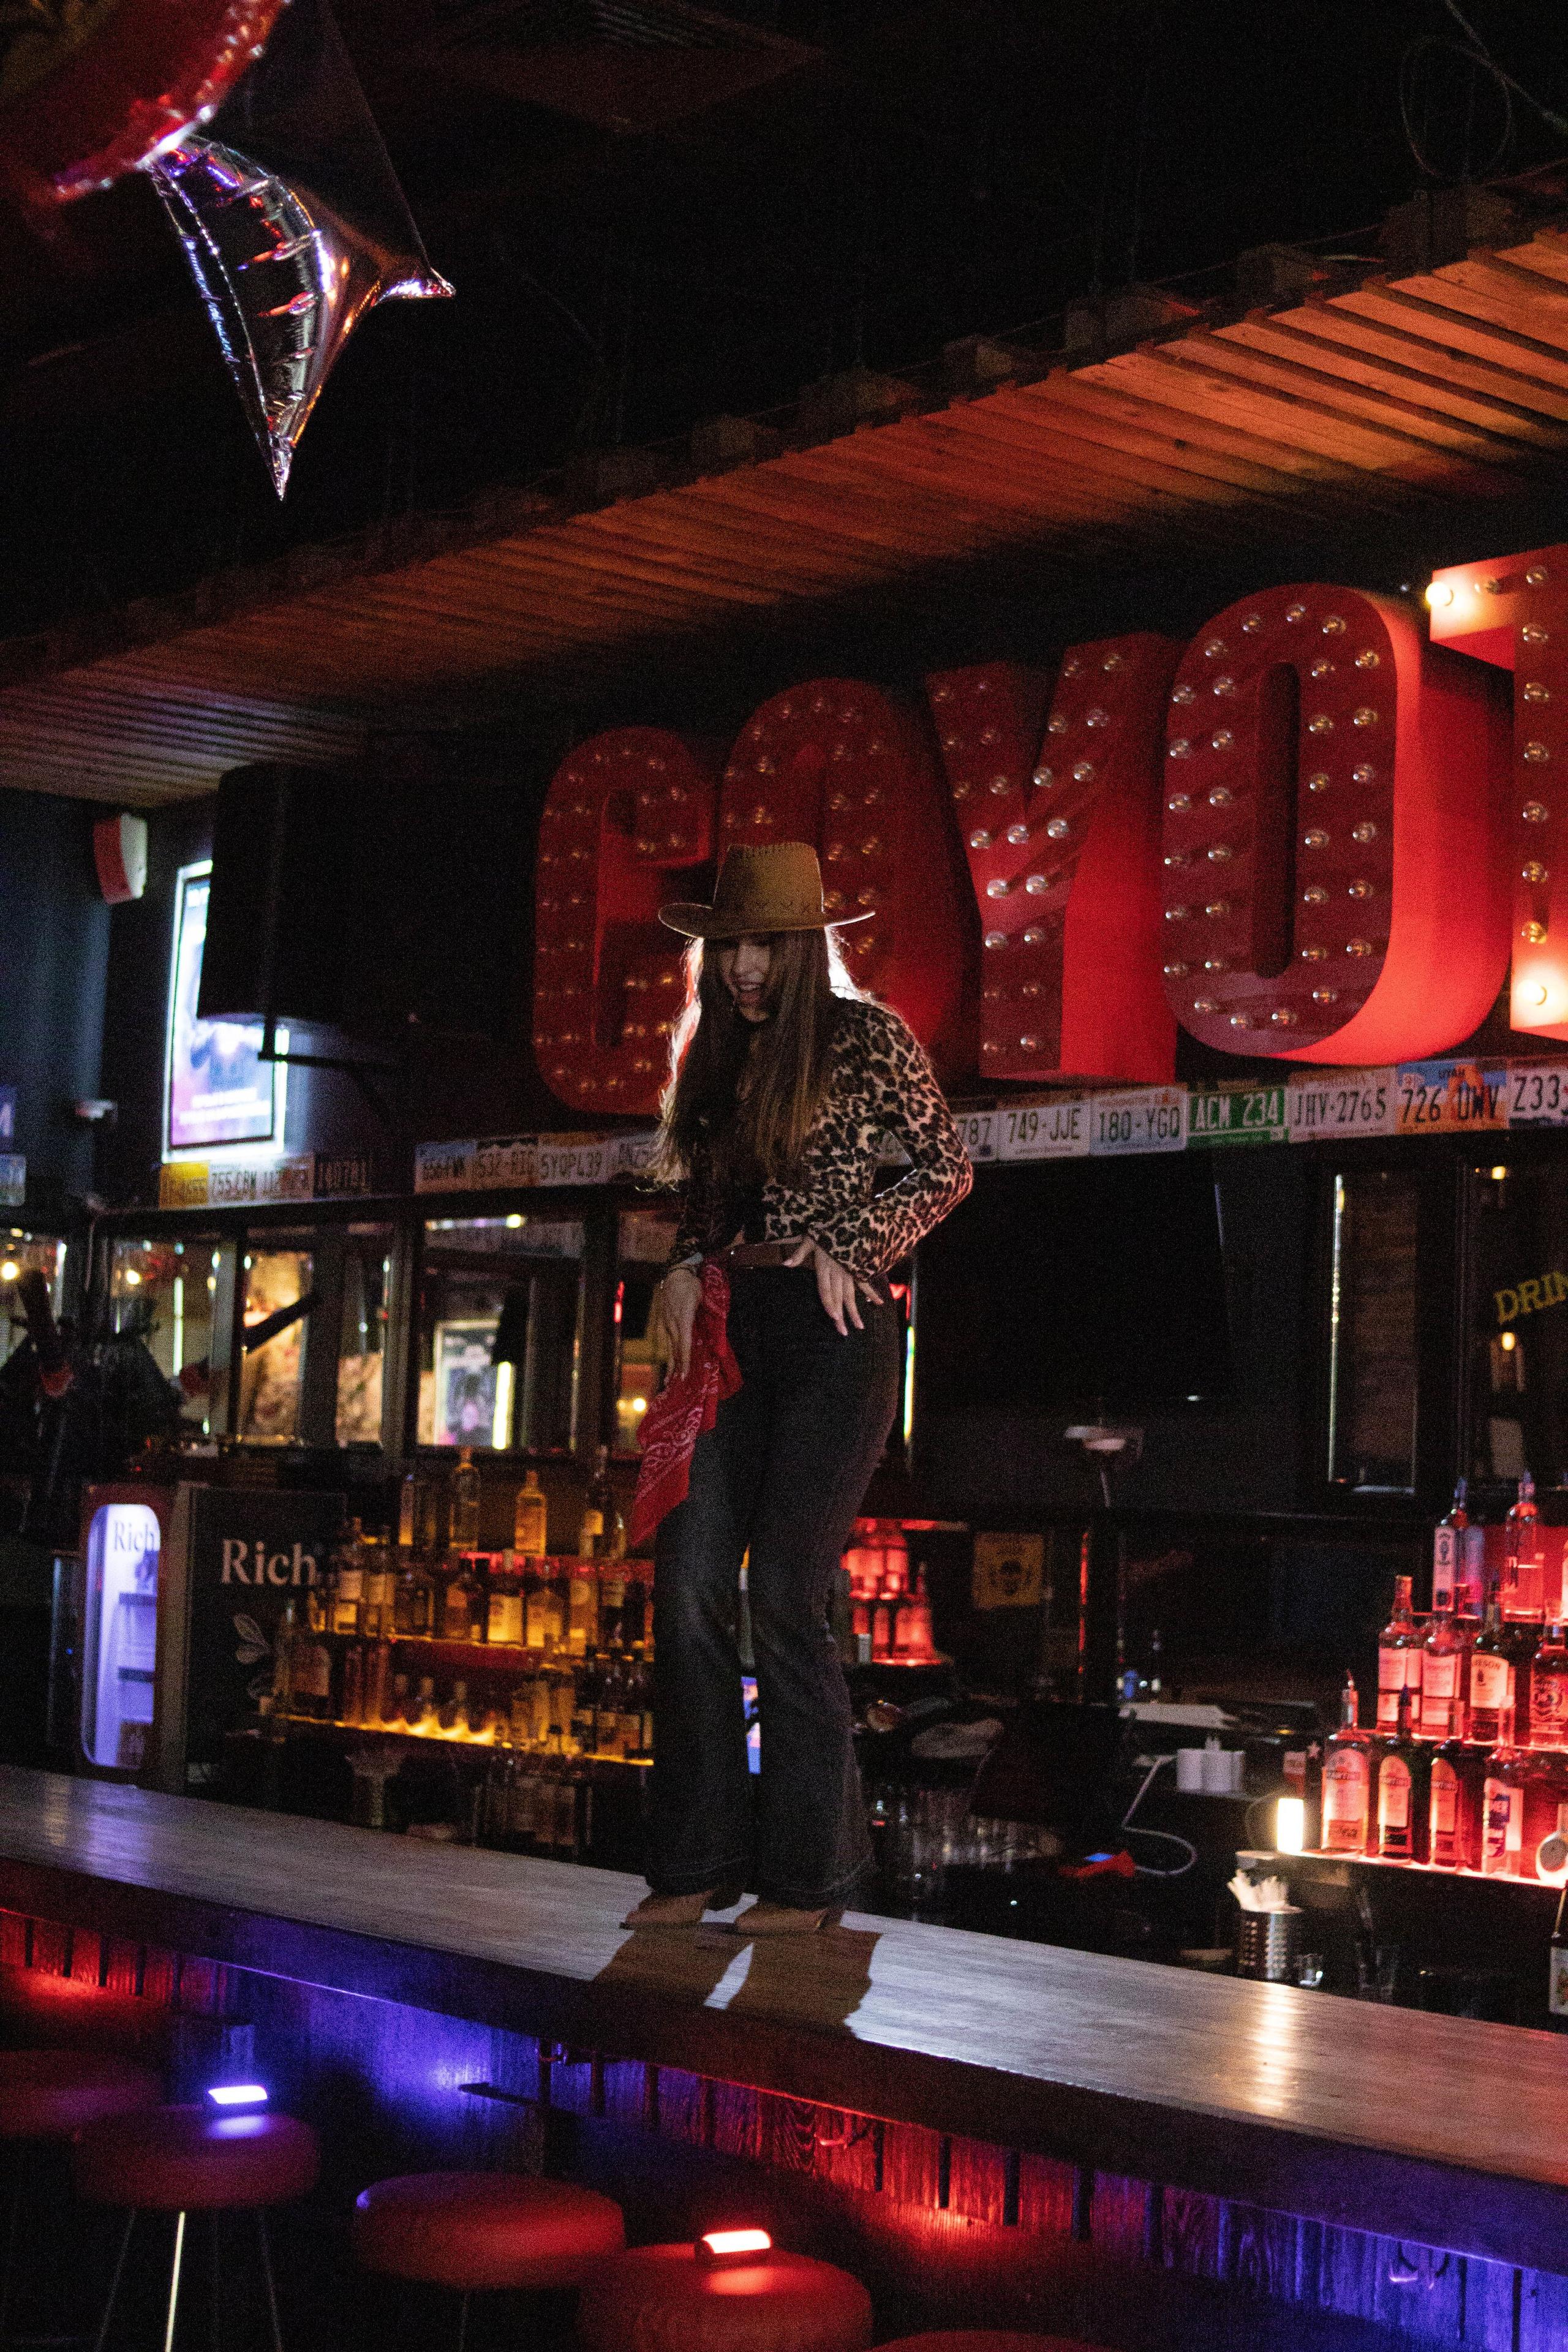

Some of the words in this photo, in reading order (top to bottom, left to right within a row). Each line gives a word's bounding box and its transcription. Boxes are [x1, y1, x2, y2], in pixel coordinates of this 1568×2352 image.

[1242, 1090, 1280, 1127] 234
[1401, 1084, 1441, 1123] 726
[1007, 1107, 1081, 1144] 749-JJE
[112, 1520, 156, 1552] Rich
[220, 1538, 317, 1586] Rich
